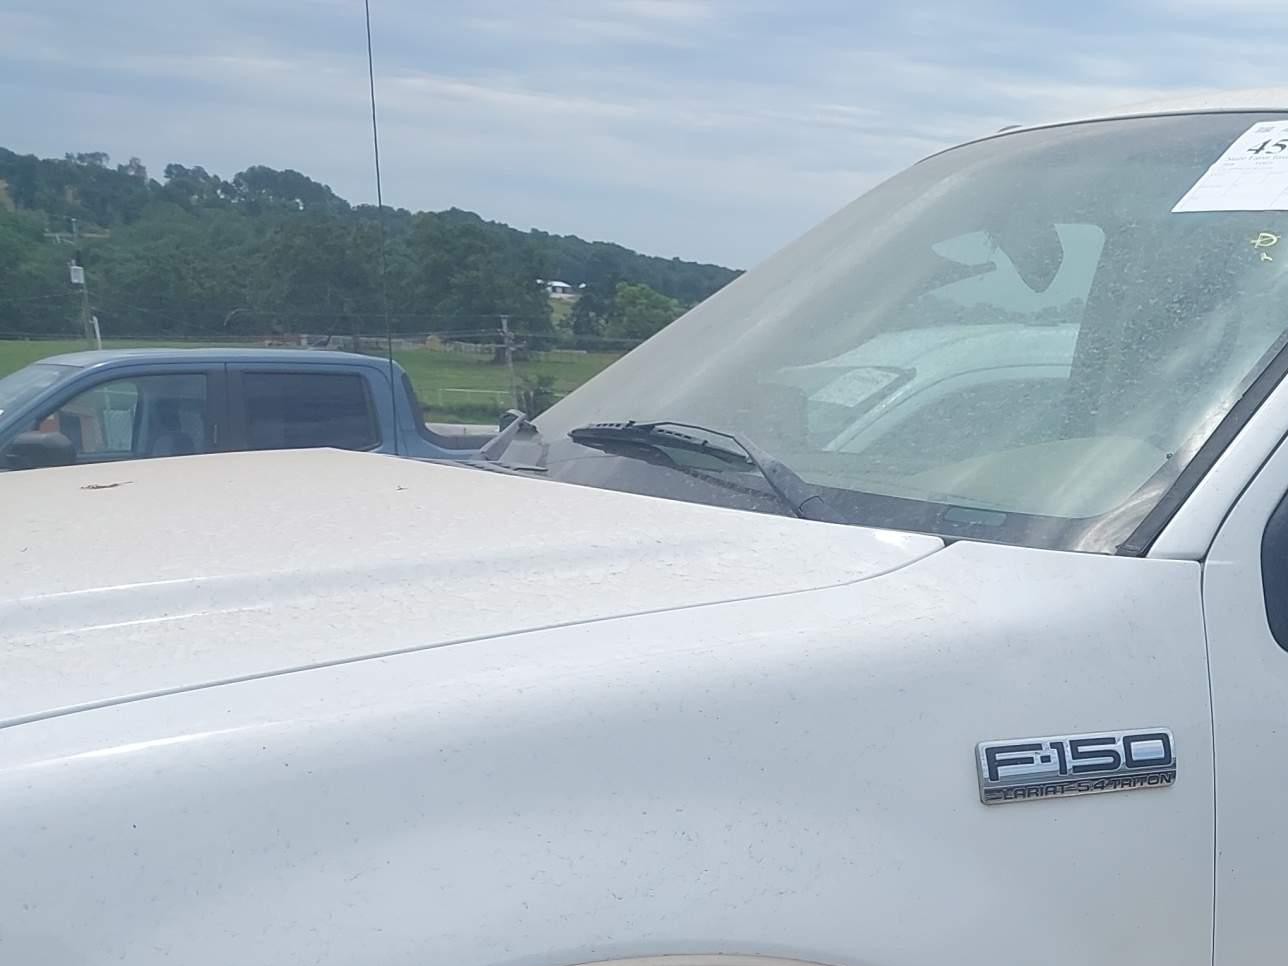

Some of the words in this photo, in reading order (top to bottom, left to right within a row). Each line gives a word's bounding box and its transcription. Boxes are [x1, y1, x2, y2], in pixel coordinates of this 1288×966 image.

[985, 733, 1172, 782] F-150
[1002, 785, 1066, 800] LARIAT
[1111, 772, 1172, 789] TRITON
